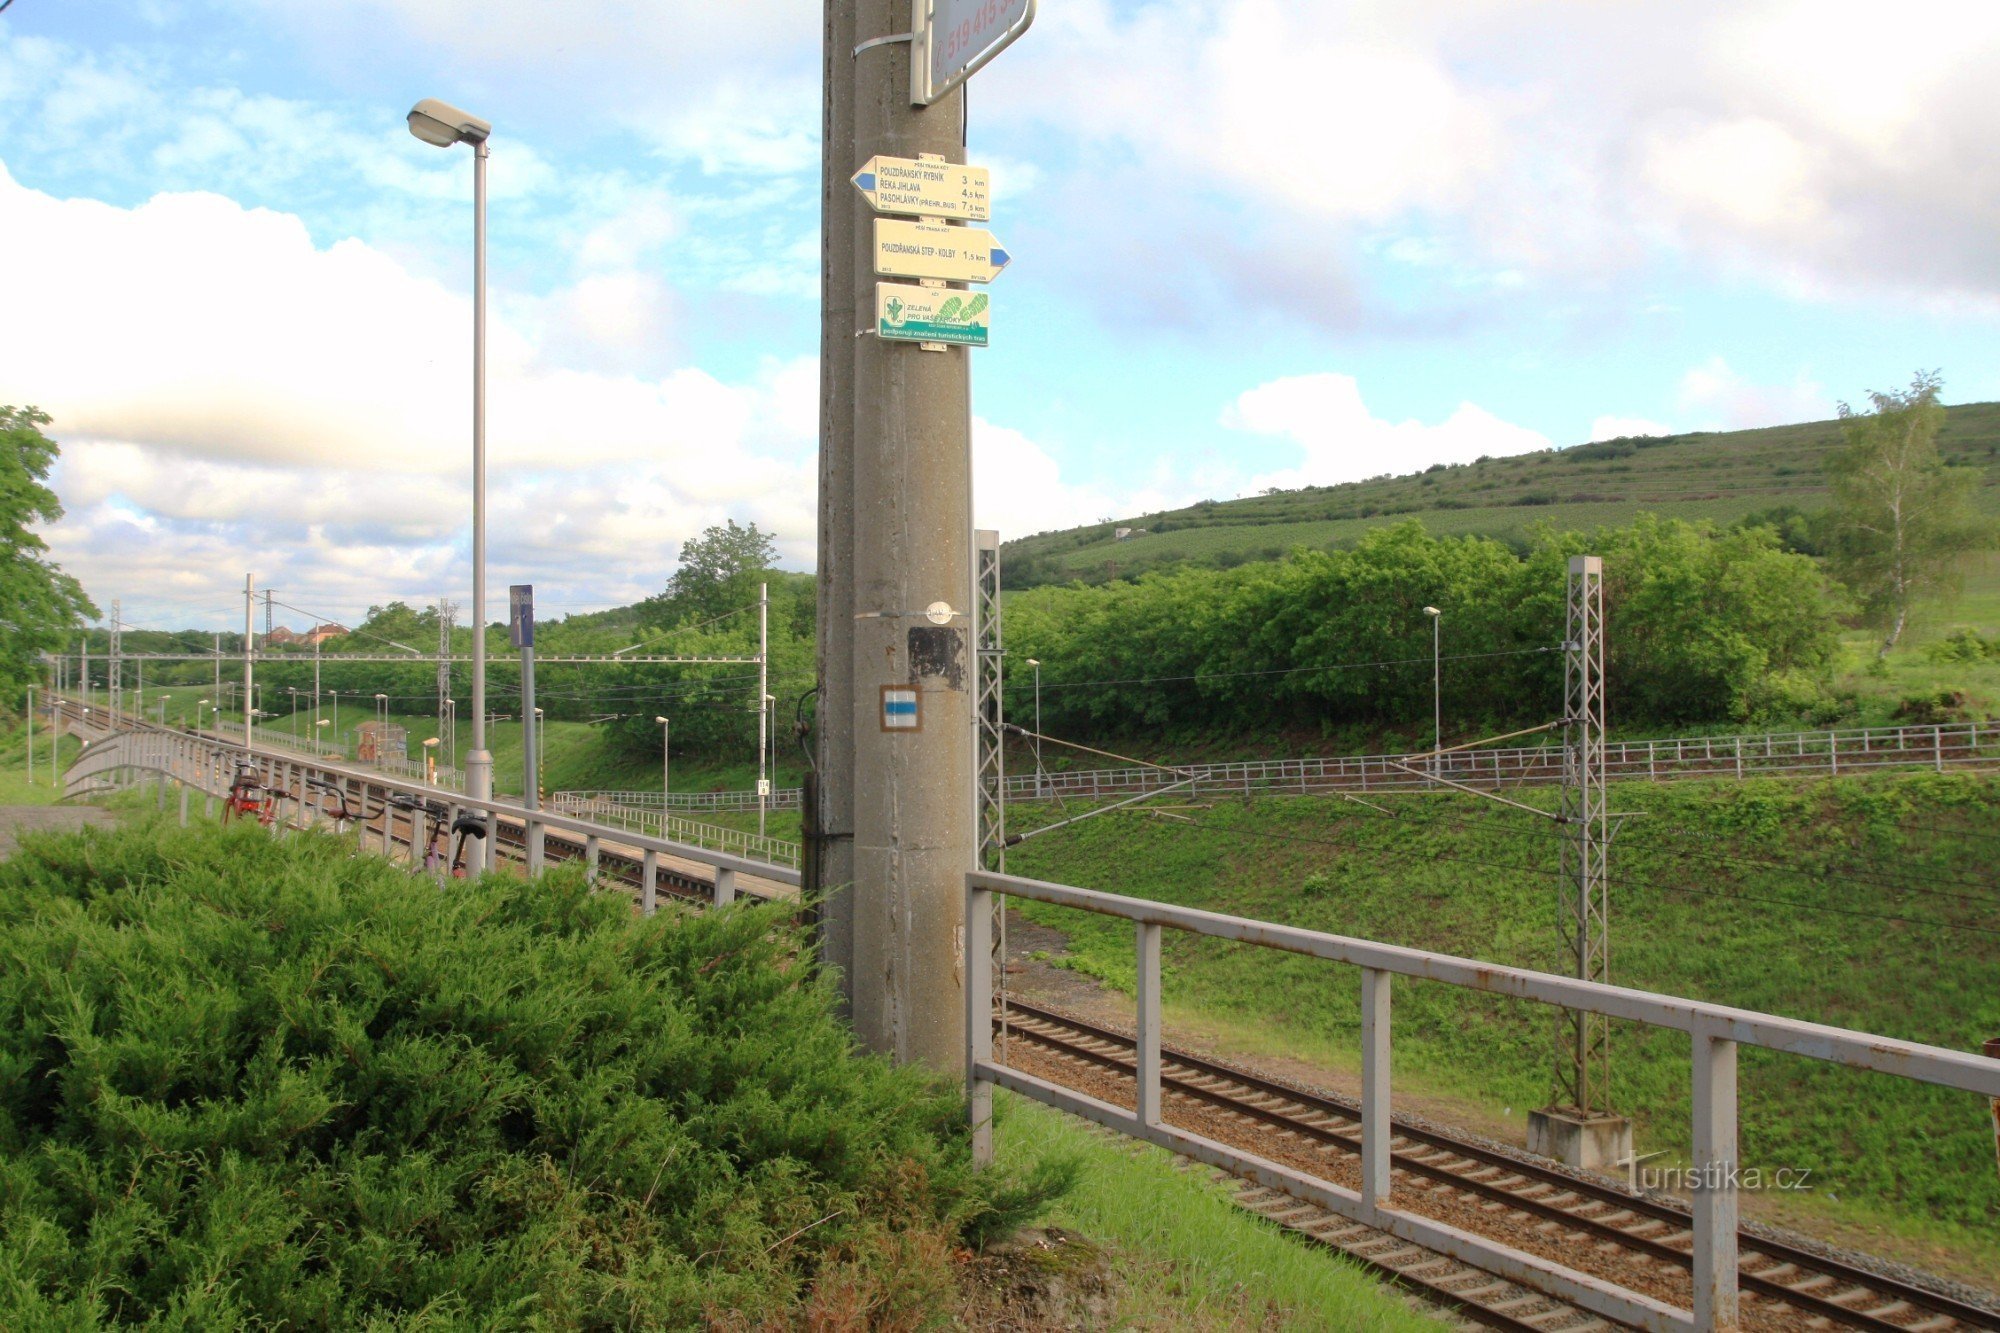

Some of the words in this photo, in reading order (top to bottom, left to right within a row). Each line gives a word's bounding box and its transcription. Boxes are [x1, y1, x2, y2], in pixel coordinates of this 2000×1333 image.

[948, 18, 970, 59] 519
[880, 166, 922, 177] POUZDŘANSKÝ
[923, 171, 944, 182] RYBNÍK
[962, 175, 968, 185] 3
[880, 179, 896, 189] ŘEKA
[897, 181, 921, 191] JIHLAVA
[962, 188, 973, 198] 4,5
[880, 192, 919, 204] PASOHLÁVKY
[962, 201, 974, 211] 7,5
[881, 243, 920, 255] POUZDŘANSKÁ
[921, 247, 935, 256] STEP
[938, 249, 956, 258] KOLBY
[963, 251, 975, 261] 1,5
[907, 304, 932, 312] ZELENÁ
[883, 328, 912, 337] podporují
[913, 330, 937, 338] značení
[938, 332, 973, 341] turistických
